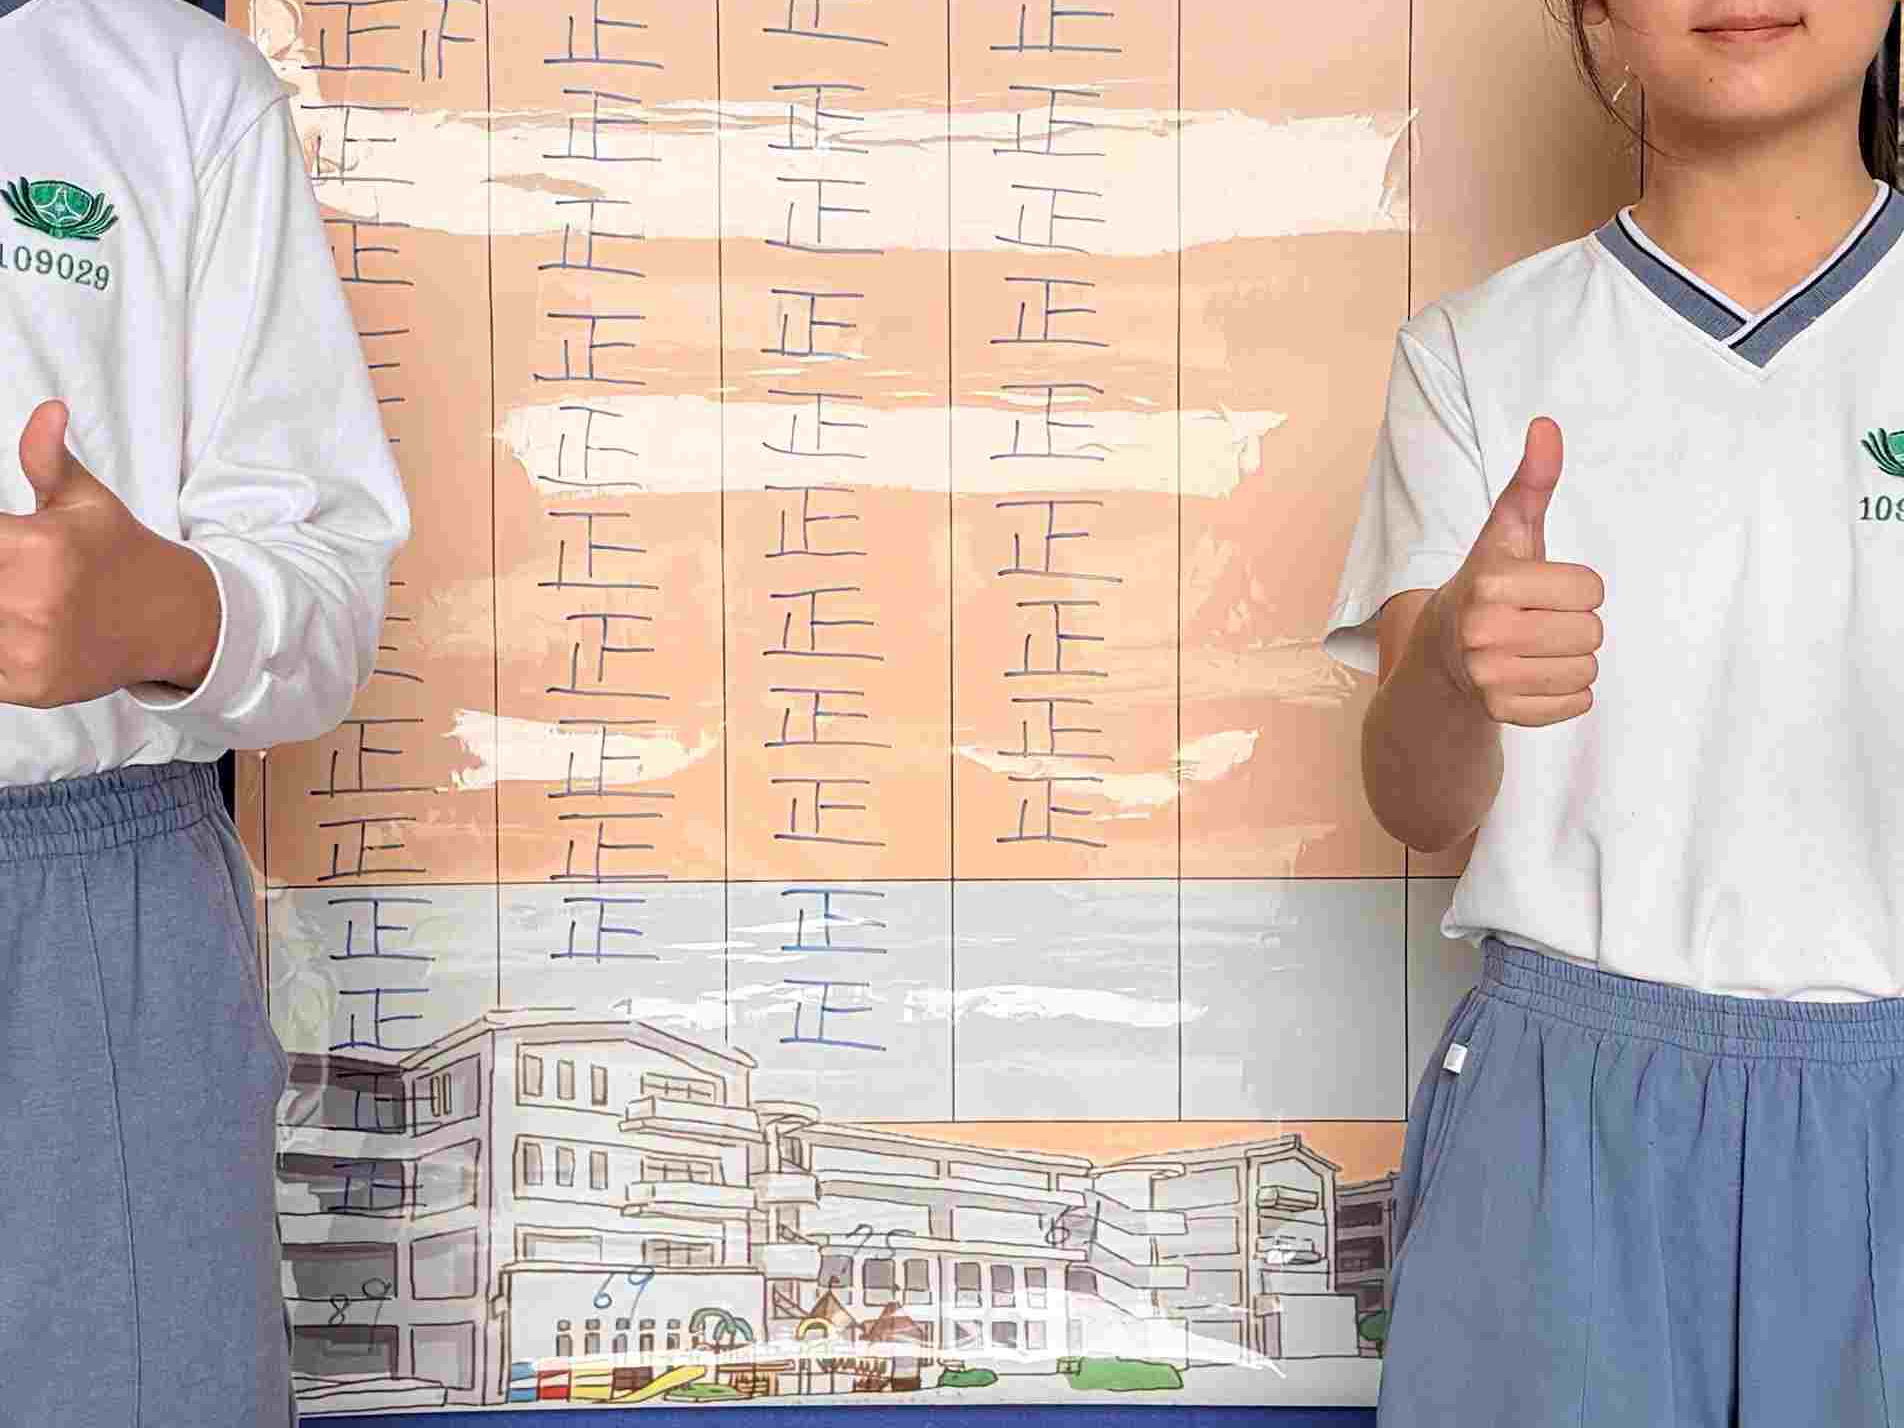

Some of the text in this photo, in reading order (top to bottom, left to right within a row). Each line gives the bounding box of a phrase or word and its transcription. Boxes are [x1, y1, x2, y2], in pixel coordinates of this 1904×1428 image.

[542, 88, 662, 162] 正
[768, 84, 869, 154] 正
[993, 84, 1106, 157] 正
[538, 199, 646, 278] 正
[765, 176, 884, 254] 正
[995, 184, 1105, 254] 正
[534, 276, 1110, 386] 正 正 正
[538, 383, 1105, 490] 正 正 正
[538, 485, 1123, 590] 正 正 正
[546, 587, 1108, 700] 正 正 正
[548, 720, 675, 798] 正
[764, 687, 892, 748] 正
[997, 698, 1114, 761] 正
[550, 813, 669, 884] 正
[771, 779, 886, 847] 正
[996, 775, 1108, 848] 正
[551, 897, 660, 964] 正
[781, 890, 888, 954] 正
[780, 979, 886, 1051] 正
